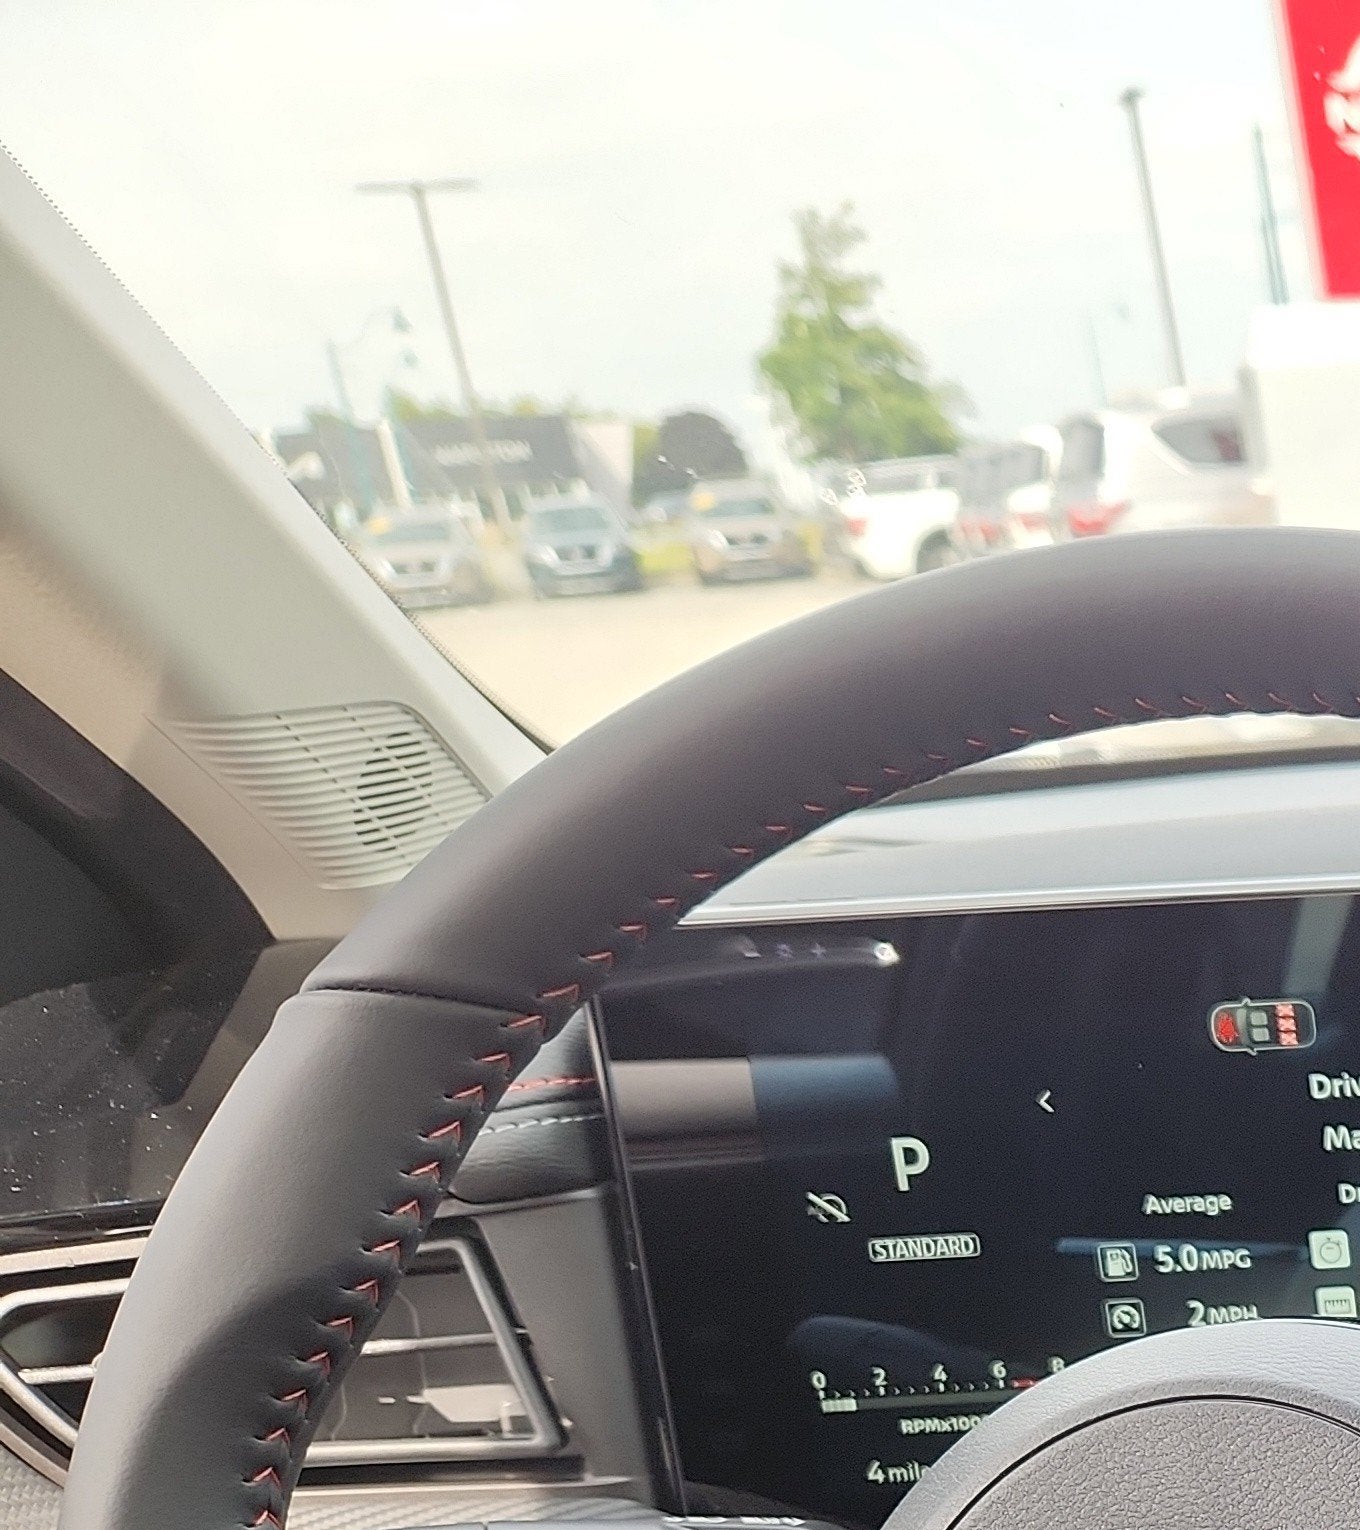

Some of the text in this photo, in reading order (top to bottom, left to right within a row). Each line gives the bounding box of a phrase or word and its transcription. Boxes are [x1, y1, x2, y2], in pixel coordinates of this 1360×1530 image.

[890, 1136, 931, 1192] P
[1142, 1193, 1233, 1216] Average
[874, 1235, 975, 1259] STANDARD
[932, 1363, 948, 1383] 4
[989, 1359, 1007, 1379] 6
[1048, 1354, 1066, 1374] 8
[810, 1370, 828, 1390] 0
[872, 1365, 888, 1386] 2
[900, 1413, 987, 1435] RPMx100
[867, 1459, 886, 1484] 4
